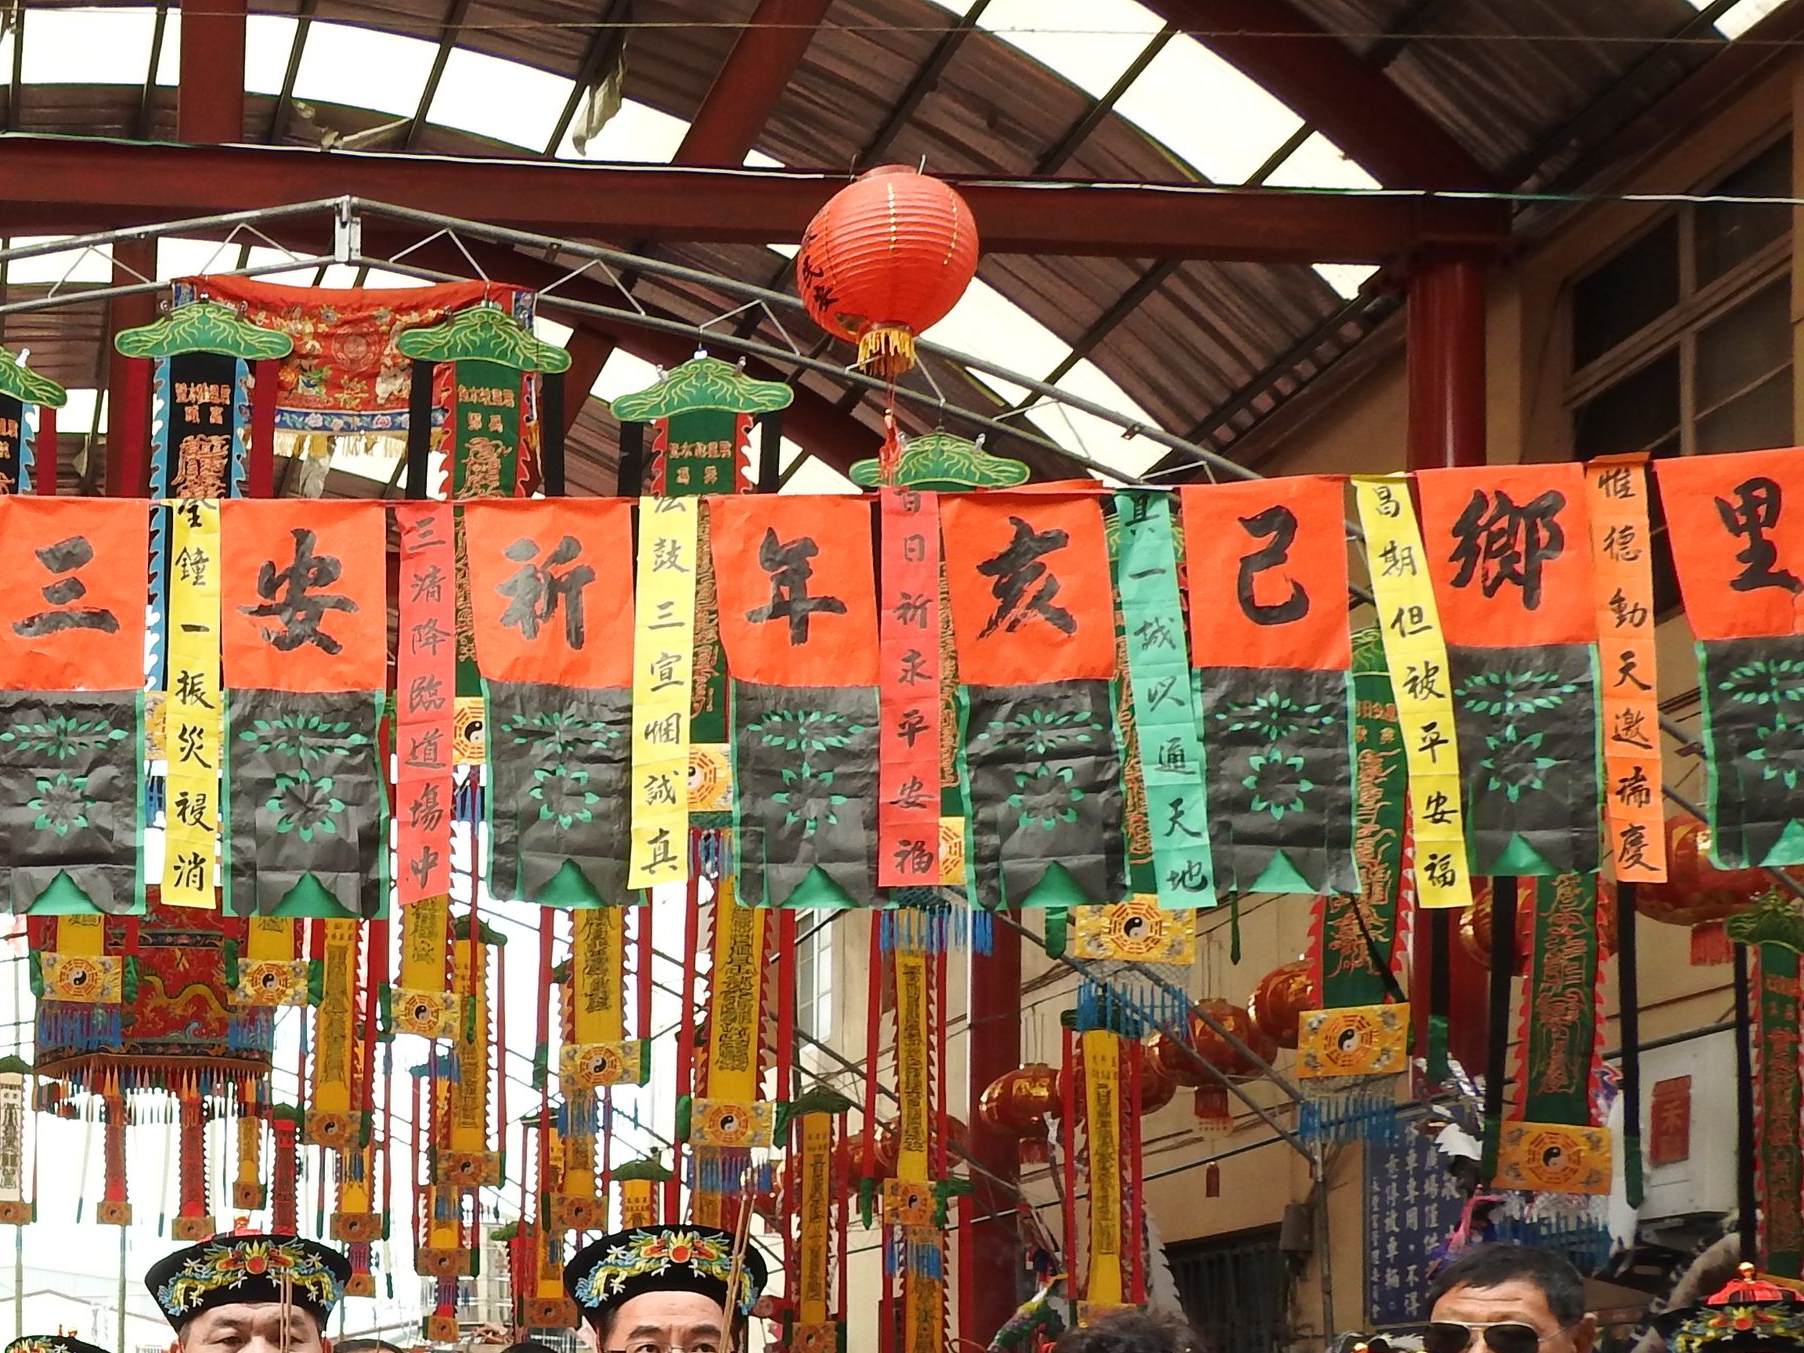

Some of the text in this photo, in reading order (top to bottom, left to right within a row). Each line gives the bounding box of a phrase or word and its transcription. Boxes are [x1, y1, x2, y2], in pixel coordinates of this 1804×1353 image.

[12, 535, 120, 636] 三
[237, 529, 358, 655] 安
[498, 536, 596, 650] 祈
[745, 527, 848, 645] 年
[976, 516, 1080, 640] 亥
[1449, 489, 1566, 611] 鄉
[1715, 477, 1804, 593] 里
[404, 517, 451, 890] 三清降臨道場中
[1598, 468, 1659, 872] 惟德動天邀瑞慶
